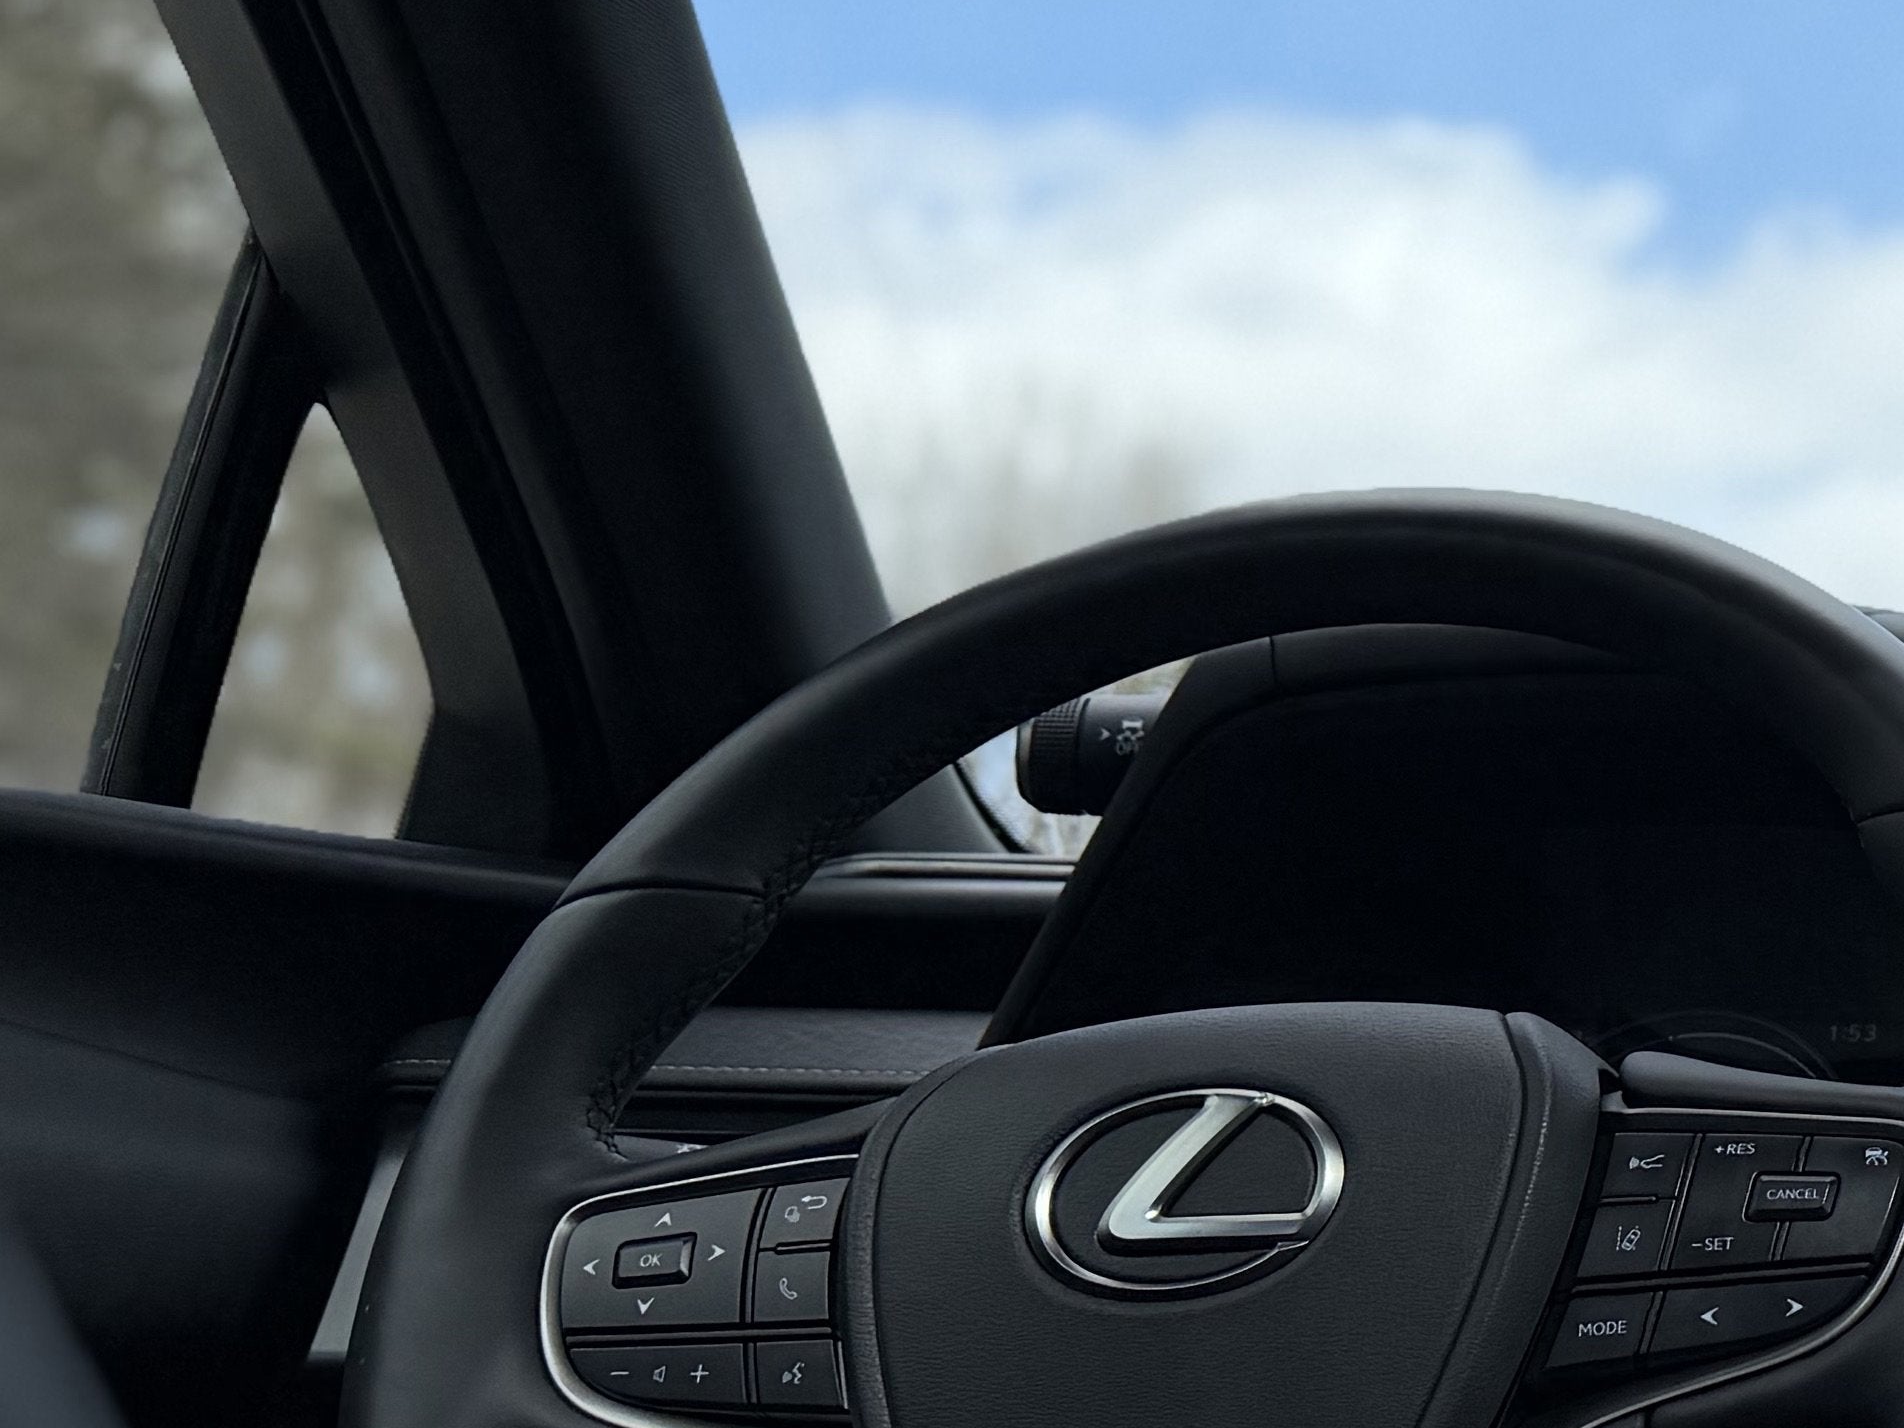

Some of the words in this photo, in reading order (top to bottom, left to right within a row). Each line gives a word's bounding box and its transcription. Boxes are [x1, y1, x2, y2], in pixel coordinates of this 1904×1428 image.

[1828, 1023, 1878, 1043] 1:53
[1766, 1187, 1820, 1201] CANCEL
[640, 1253, 664, 1268] OK
[1577, 1320, 1628, 1338] MODE
